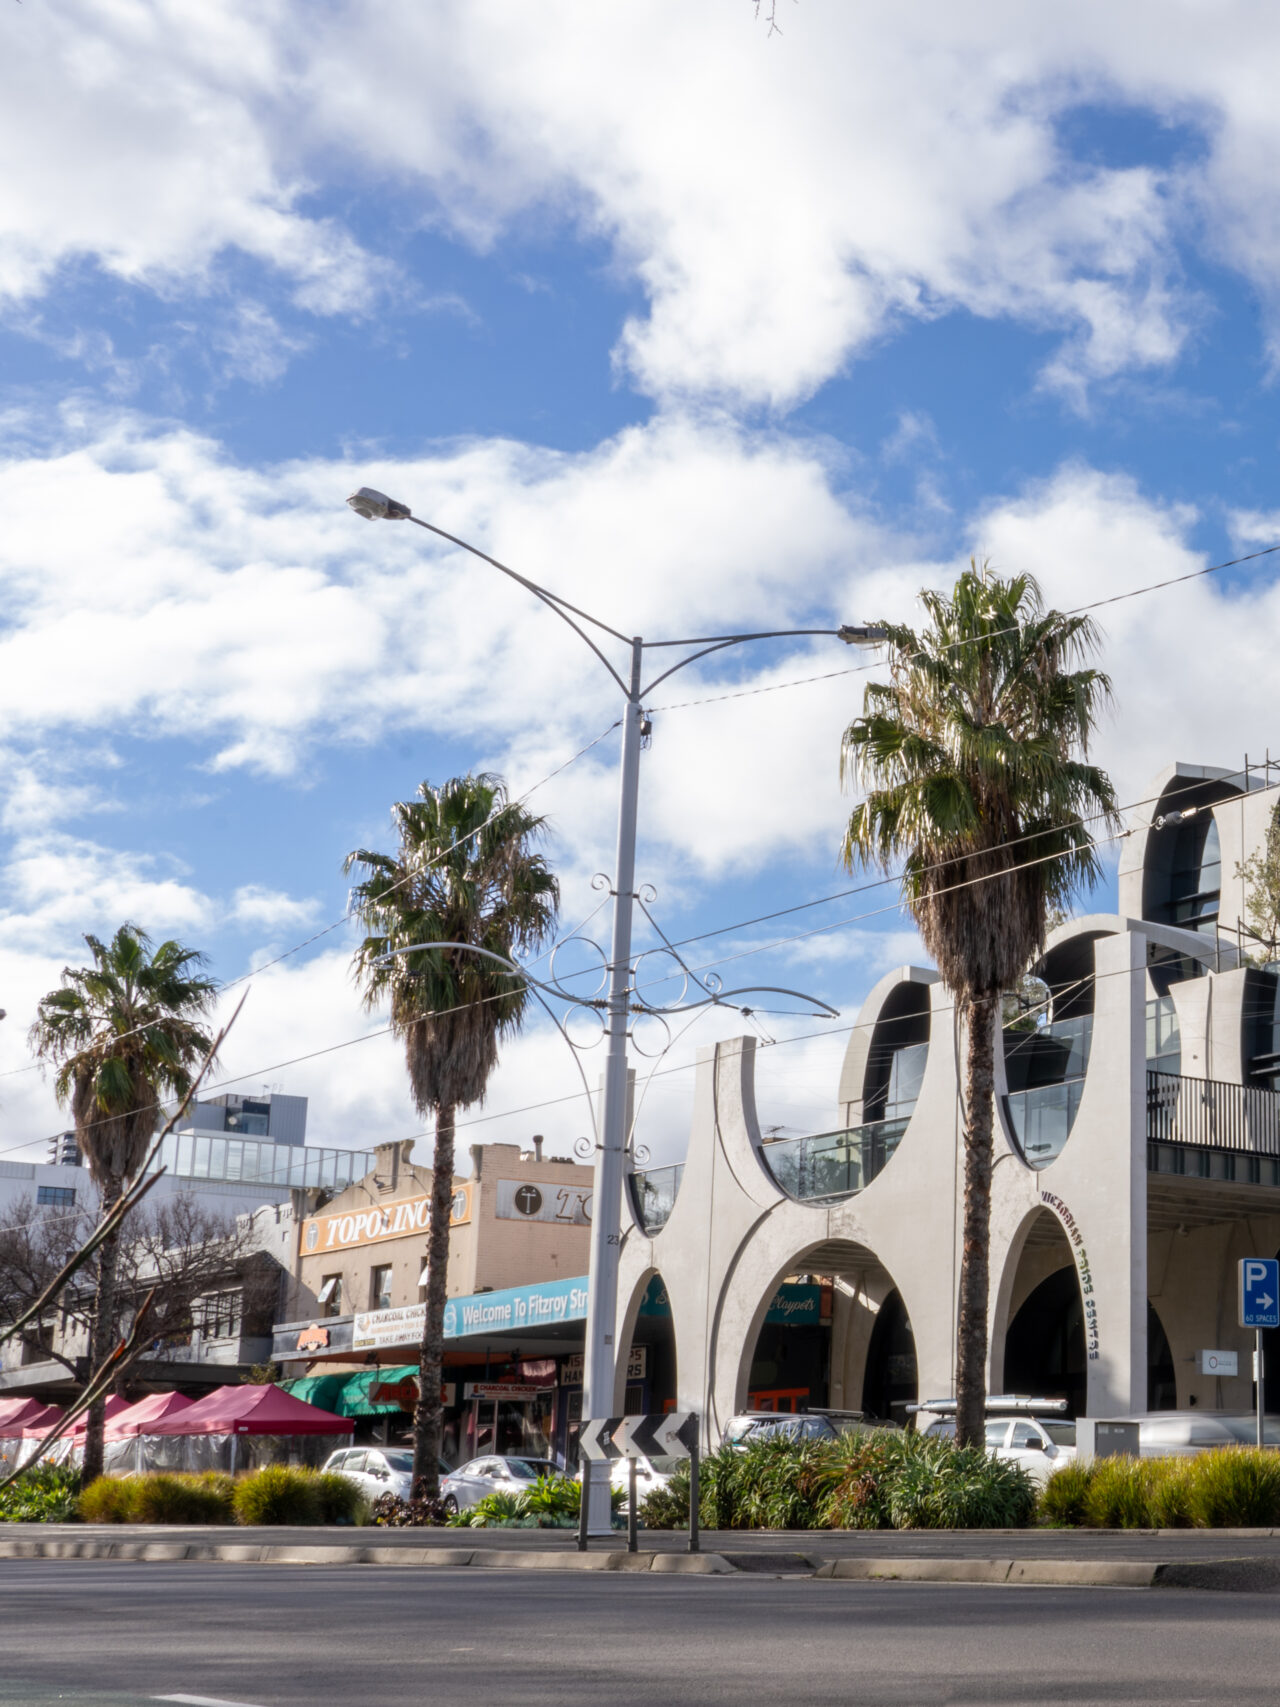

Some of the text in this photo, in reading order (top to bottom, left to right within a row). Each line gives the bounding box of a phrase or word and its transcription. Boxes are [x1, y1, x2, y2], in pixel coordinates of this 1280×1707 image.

[325, 1199, 431, 1247] TOPOLINO
[607, 1235, 619, 1245] 23
[1041, 1190, 1100, 1361] VICTORIAN PRIDE CENTRE
[1246, 1262, 1267, 1291] P
[463, 1289, 589, 1325] Welcome To Fitzroy Str
[1255, 1314, 1277, 1323] SPACES
